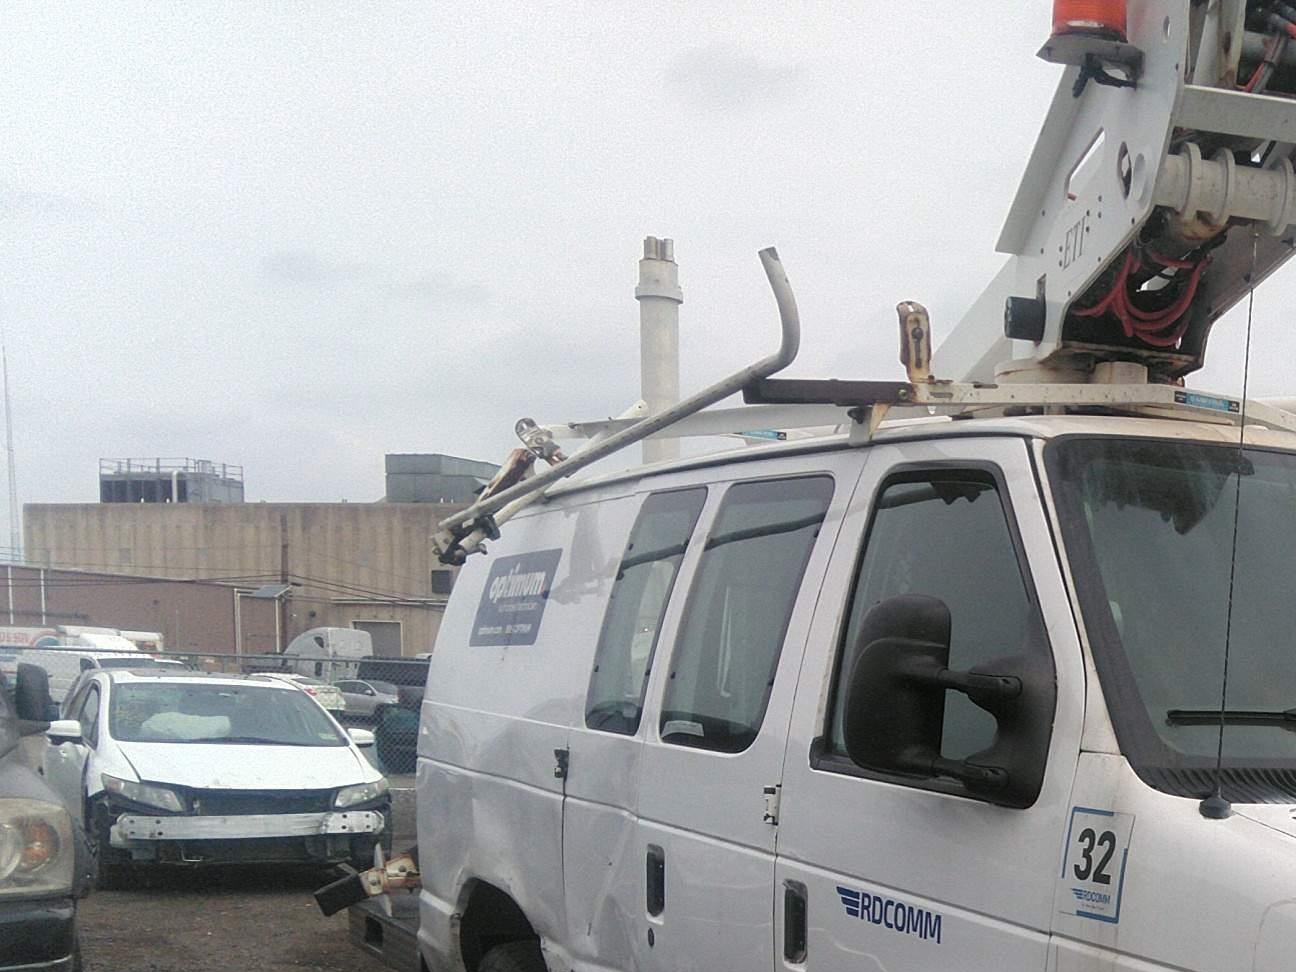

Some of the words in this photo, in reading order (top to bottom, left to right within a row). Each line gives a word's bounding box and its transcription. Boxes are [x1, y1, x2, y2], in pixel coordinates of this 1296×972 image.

[1062, 215, 1086, 271] ETI
[1073, 827, 1116, 885] 32
[860, 892, 943, 945] RDCOMM
